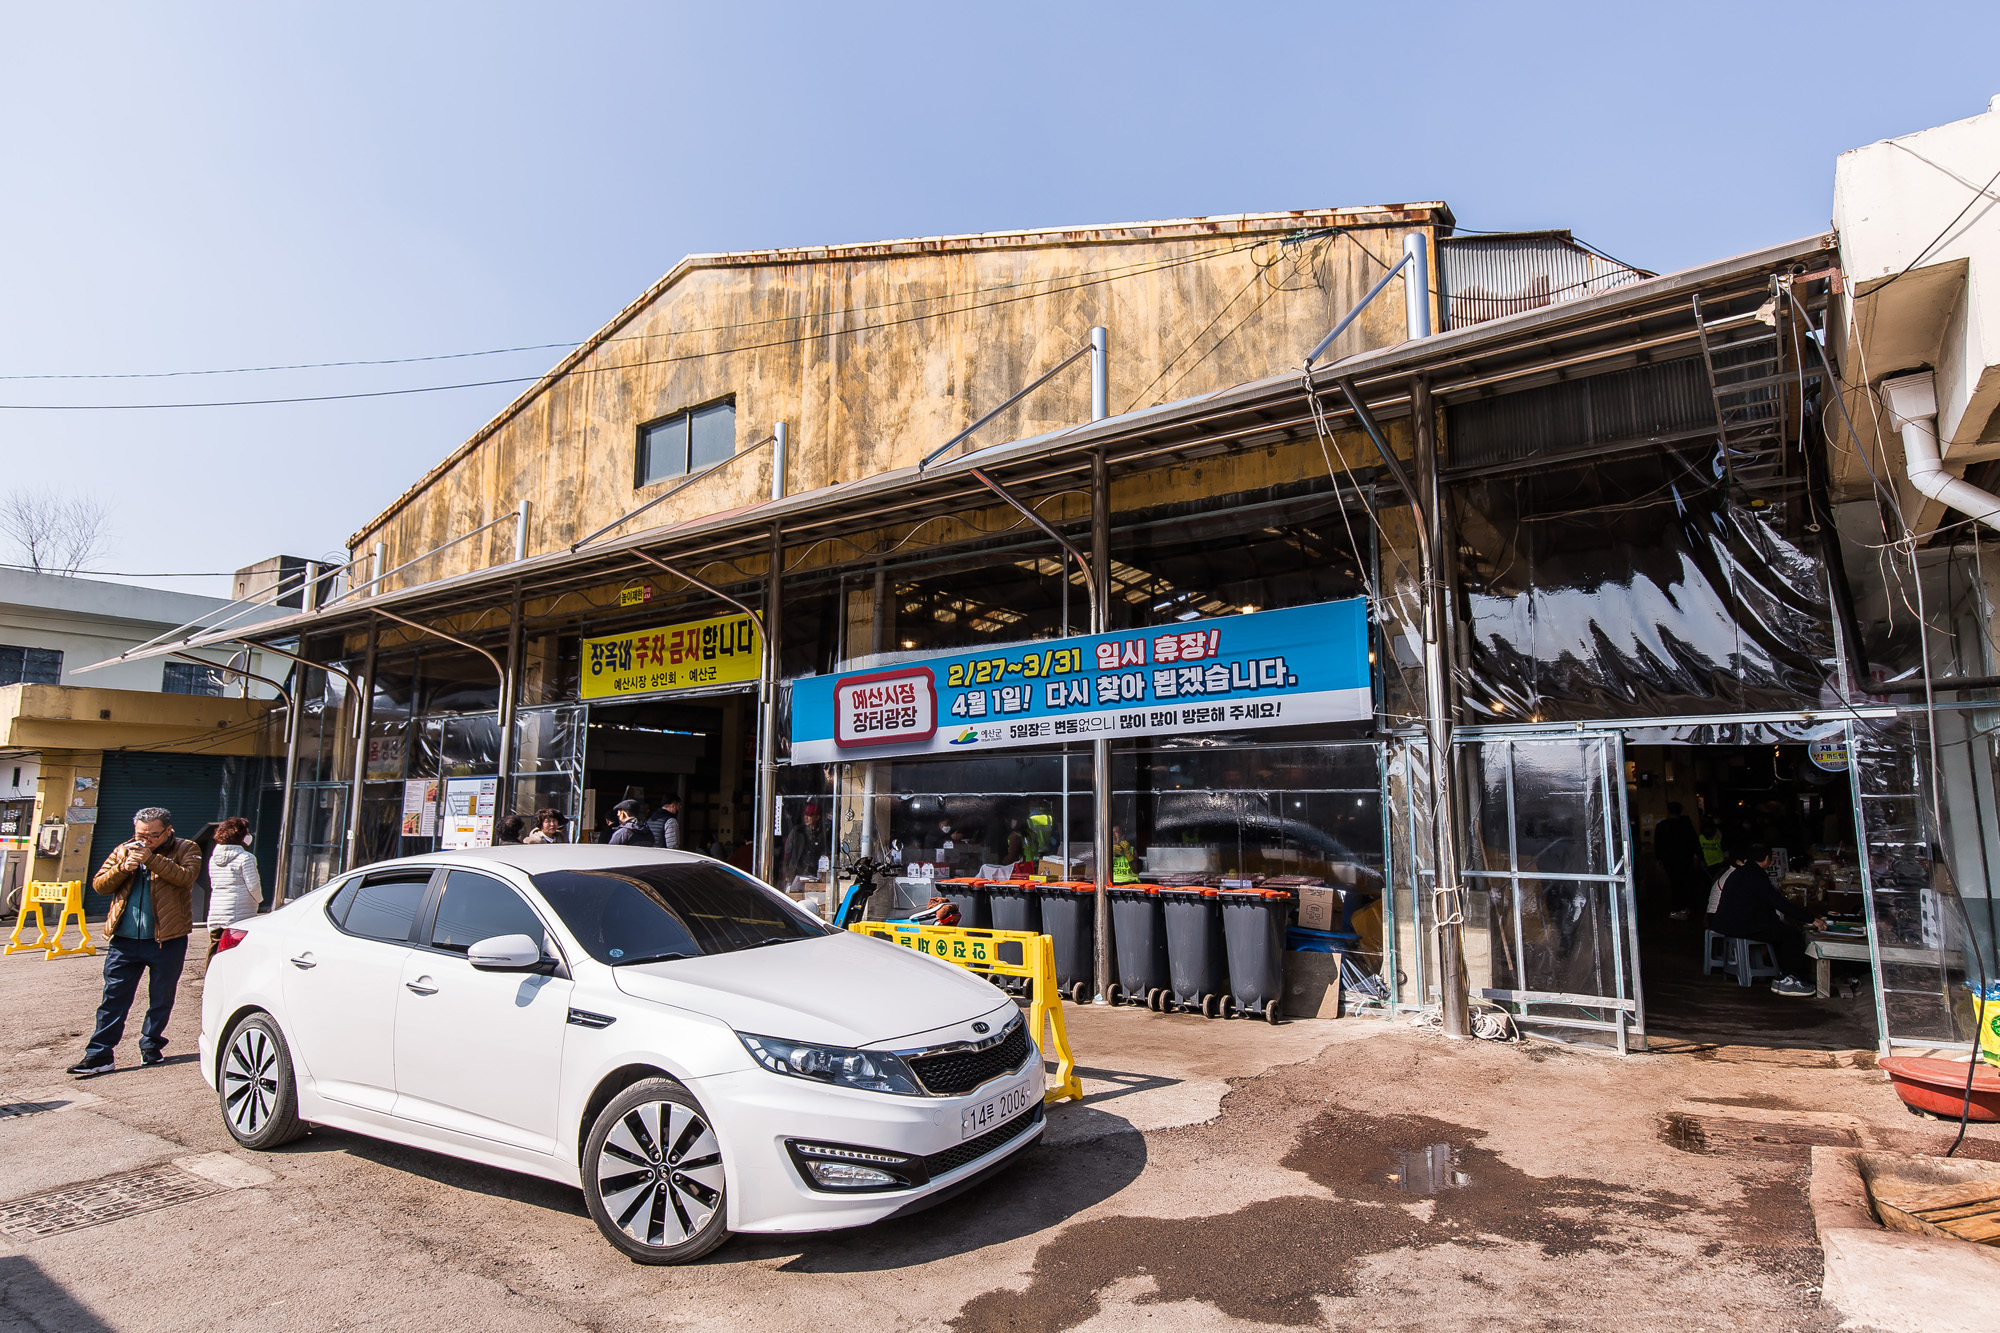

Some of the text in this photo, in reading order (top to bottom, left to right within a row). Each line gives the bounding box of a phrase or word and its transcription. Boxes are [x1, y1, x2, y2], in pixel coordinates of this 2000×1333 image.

[591, 638, 633, 675] 장옥내
[636, 633, 665, 669] 주차
[948, 628, 1220, 687] 2/27~3/31 임시 휴장!
[614, 666, 717, 691] 예산시장 상인회 예산군
[951, 657, 1298, 718] 4월 1일! 다시 찾아 뵙겠습니다.
[852, 683, 916, 710] 예산시장
[853, 706, 917, 733] 장터광장
[980, 728, 1002, 738] 예산군
[1010, 702, 1281, 739] 5일장은 변동없으니 많이 많이 방문해 주세요!
[953, 940, 987, 961] 안전
[970, 1086, 1026, 1131] 14루 2006
